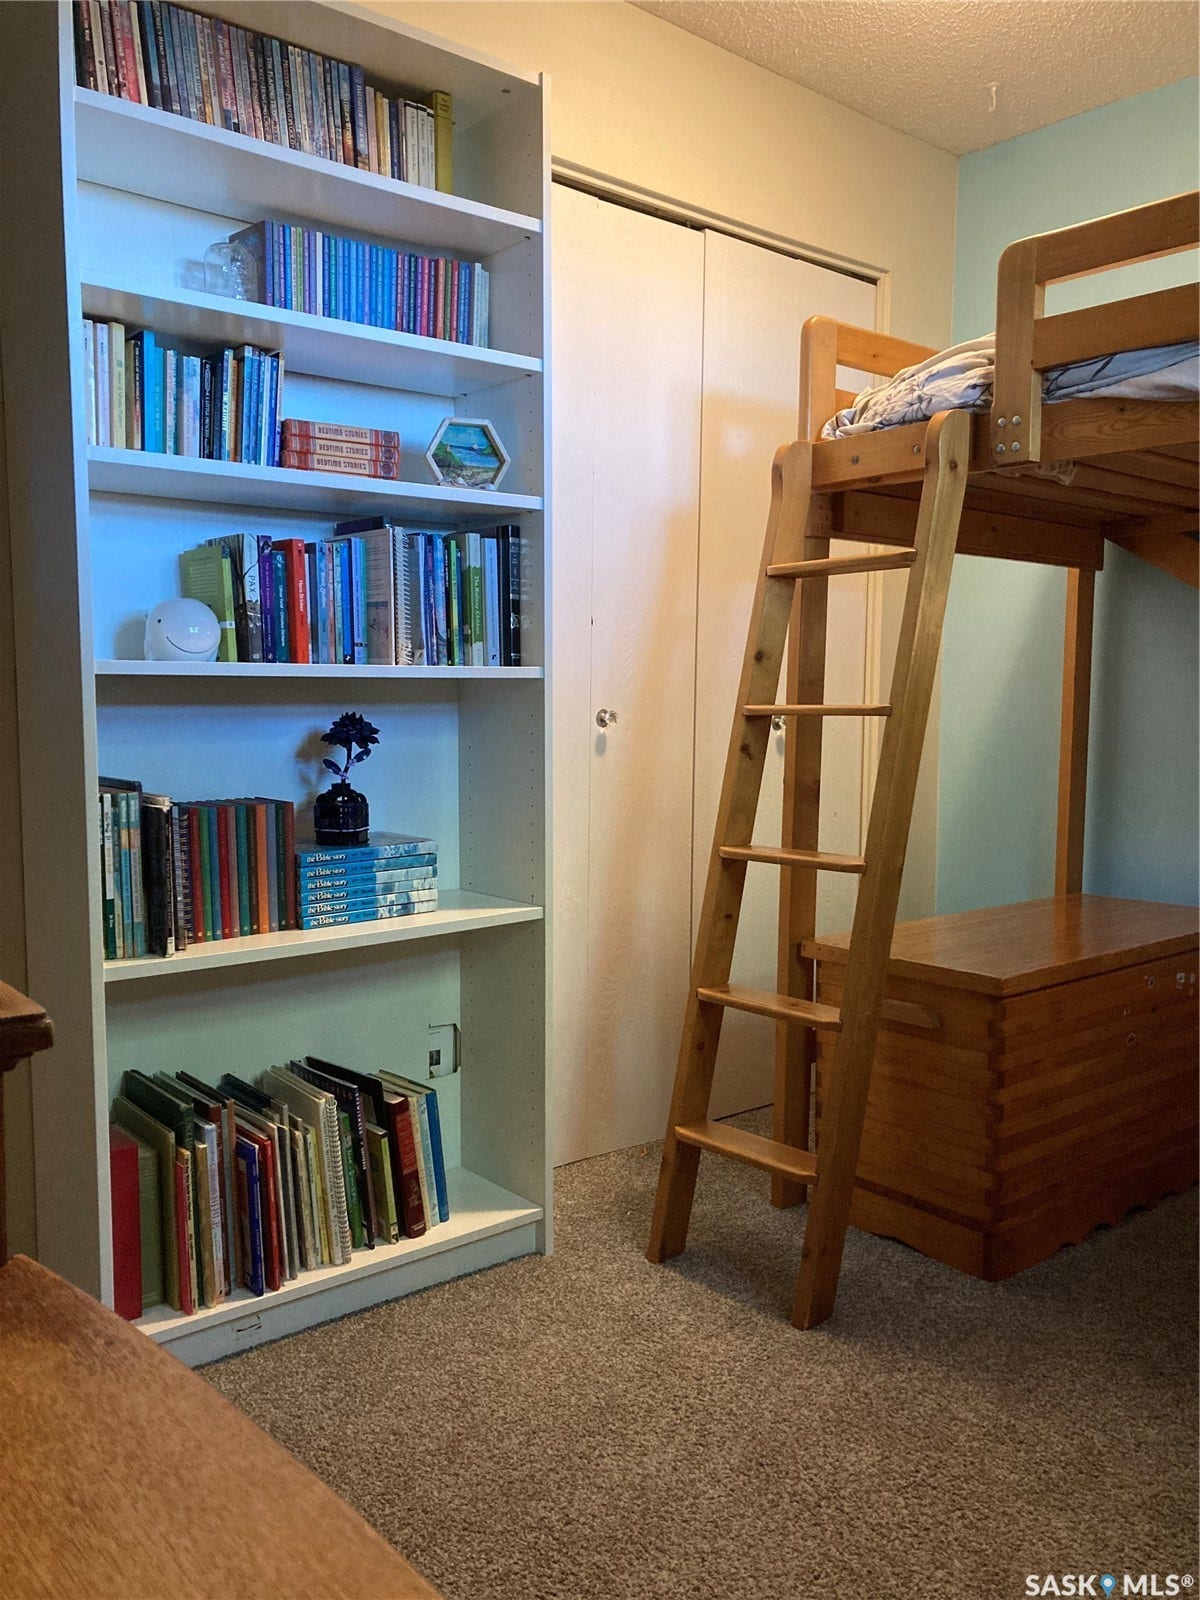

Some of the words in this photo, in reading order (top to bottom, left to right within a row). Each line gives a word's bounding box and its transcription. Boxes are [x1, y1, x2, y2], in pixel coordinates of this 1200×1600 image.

[317, 426, 343, 437] BEDTIME
[344, 428, 368, 439] STORIES
[318, 443, 344, 453] BEDTIME
[345, 445, 369, 456] STORIES
[316, 458, 343, 467] BEDTIME
[343, 460, 367, 470] STORIES
[307, 855, 316, 863] the
[316, 853, 332, 862] Bible
[332, 853, 347, 861] story
[307, 869, 316, 877] the
[316, 867, 332, 876] Bible
[308, 881, 317, 889] the
[317, 880, 332, 888] Bible
[333, 879, 347, 887] story
[317, 892, 333, 900] Bible
[333, 891, 347, 899] story
[317, 904, 333, 912] Bible
[333, 903, 348, 911] story
[310, 918, 319, 926] the
[319, 916, 335, 925] Bible
[335, 915, 350, 924] story
[210, 1196, 220, 1229] BIBLE
